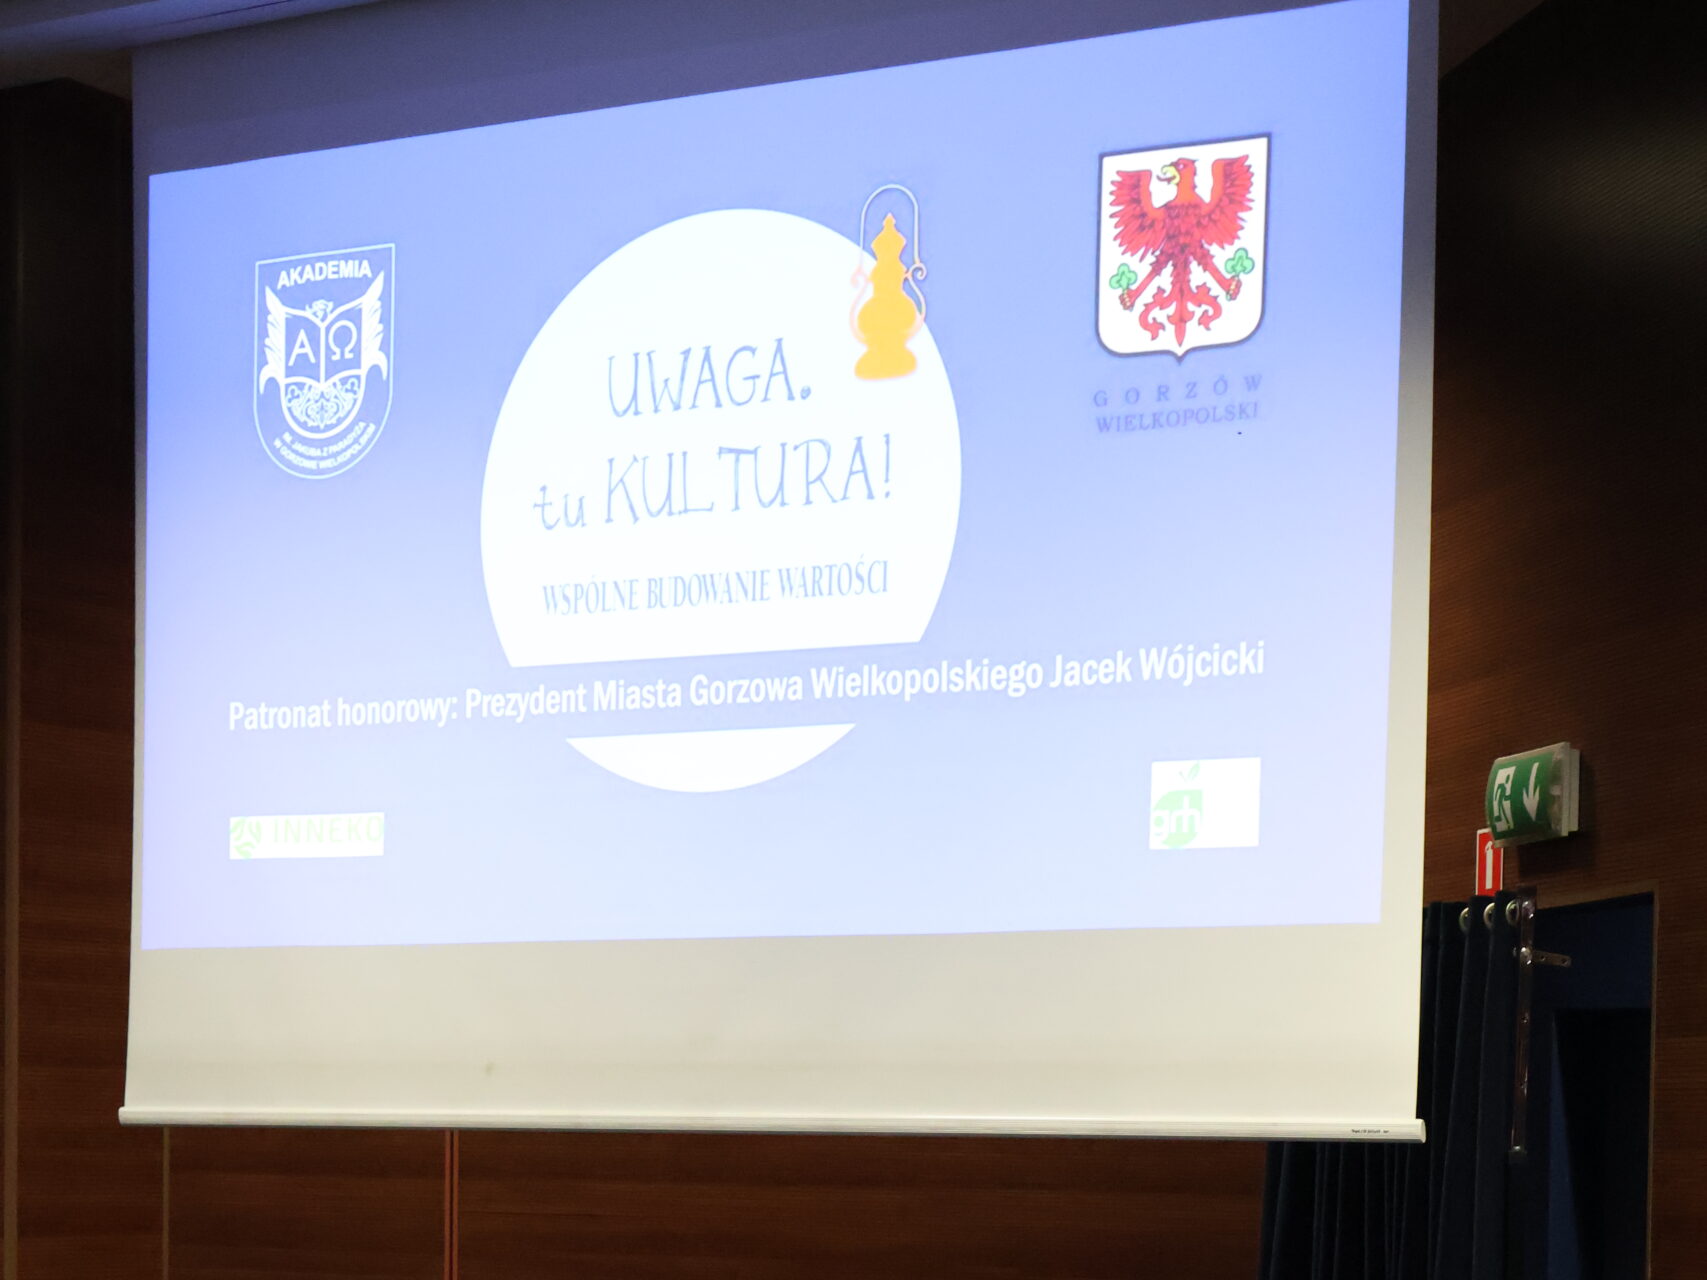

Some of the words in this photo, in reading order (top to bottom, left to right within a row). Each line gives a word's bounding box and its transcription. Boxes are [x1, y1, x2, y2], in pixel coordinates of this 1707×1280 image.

[277, 259, 372, 290] AKADEMIA
[608, 337, 812, 418] UWAGA.
[1096, 401, 1259, 433] WIELKOPOLSKI
[533, 484, 587, 531] tu
[604, 433, 892, 524] KULTURA!
[542, 574, 639, 616] WSPÓLNE
[647, 569, 771, 609] BUDOWANIE
[777, 553, 889, 599] WARTOŚCI
[229, 698, 331, 731] Patronat
[337, 696, 458, 727] honorowy:
[465, 682, 587, 723] Prezydent
[593, 678, 682, 712] Miasta
[689, 674, 803, 707] Gorzowa
[810, 657, 1043, 702] Wielkopolskiego
[1049, 649, 1132, 688] Jacek
[1139, 639, 1265, 688] Wójcicki
[274, 814, 384, 843] INNEKO
